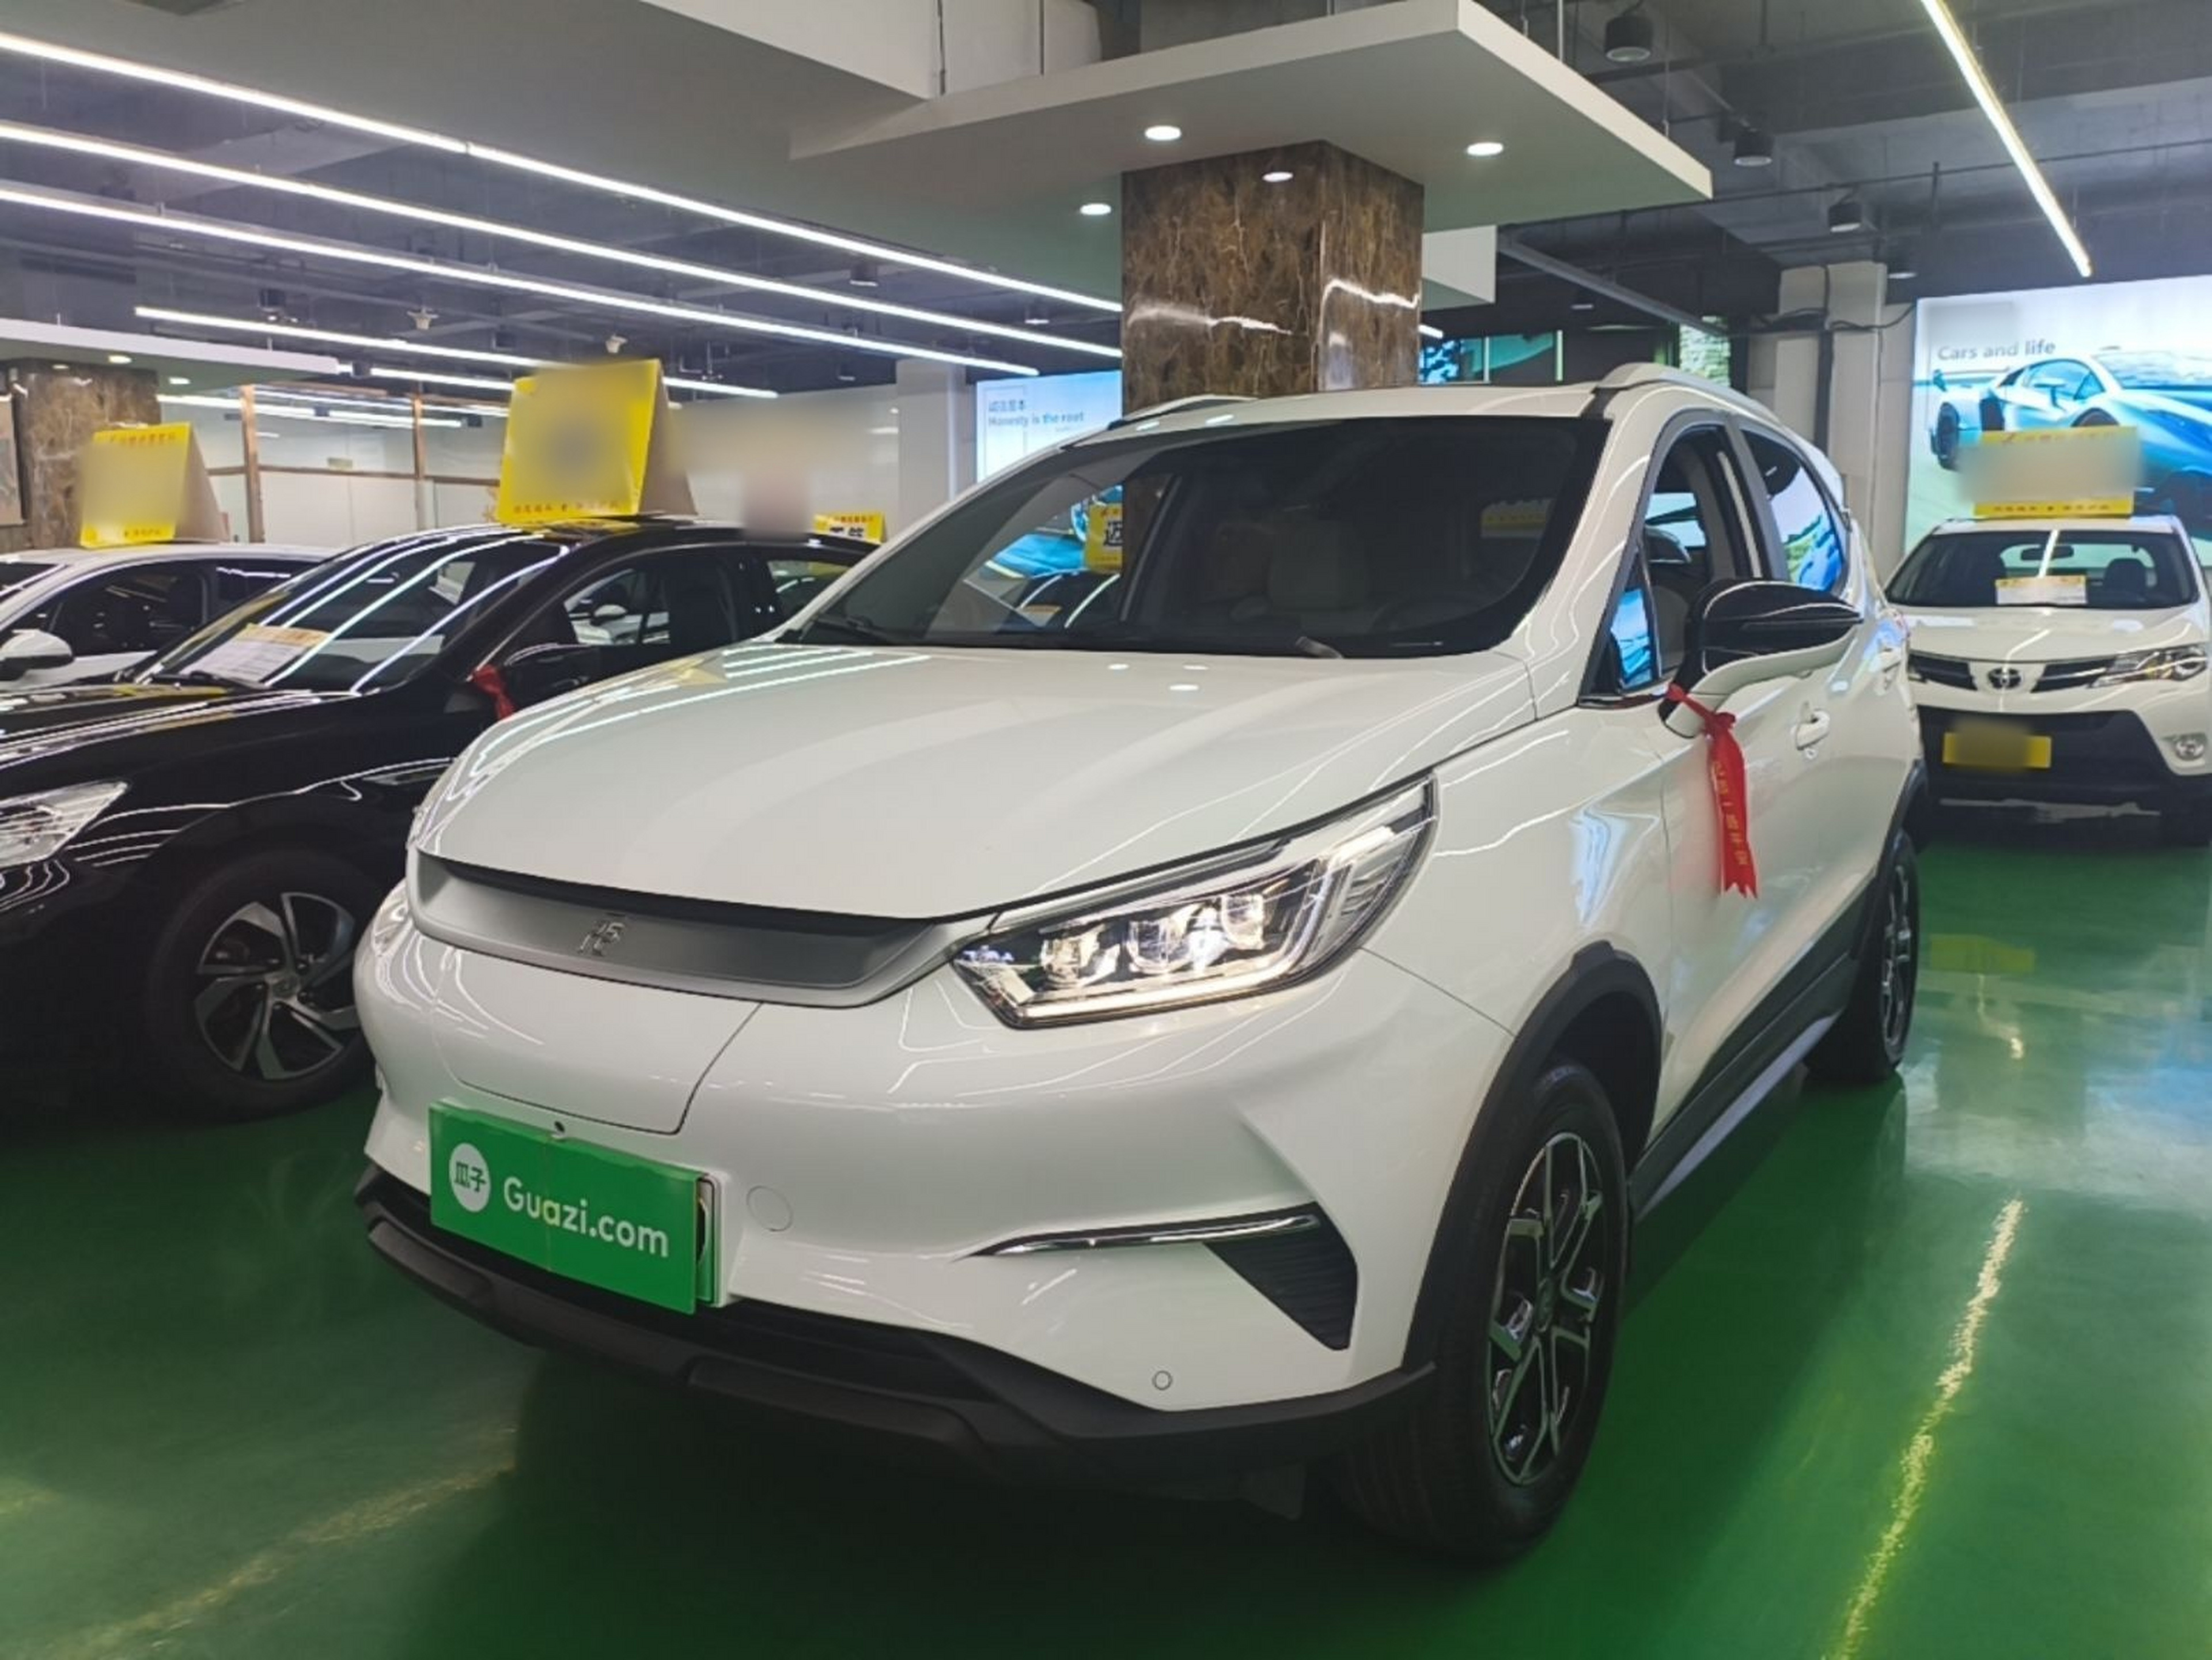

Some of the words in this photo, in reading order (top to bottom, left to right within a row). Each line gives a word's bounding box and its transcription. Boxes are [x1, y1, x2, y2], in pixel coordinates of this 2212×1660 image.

[1937, 345, 1978, 361] Cars
[1983, 341, 2019, 358] and
[2025, 338, 2056, 357] life
[988, 417, 1028, 427] Honesty
[1032, 411, 1040, 424] is
[1043, 411, 1059, 424] the
[1062, 410, 1084, 422] root
[453, 1161, 487, 1193] 瓜子
[503, 1176, 669, 1258] Guazi.com
